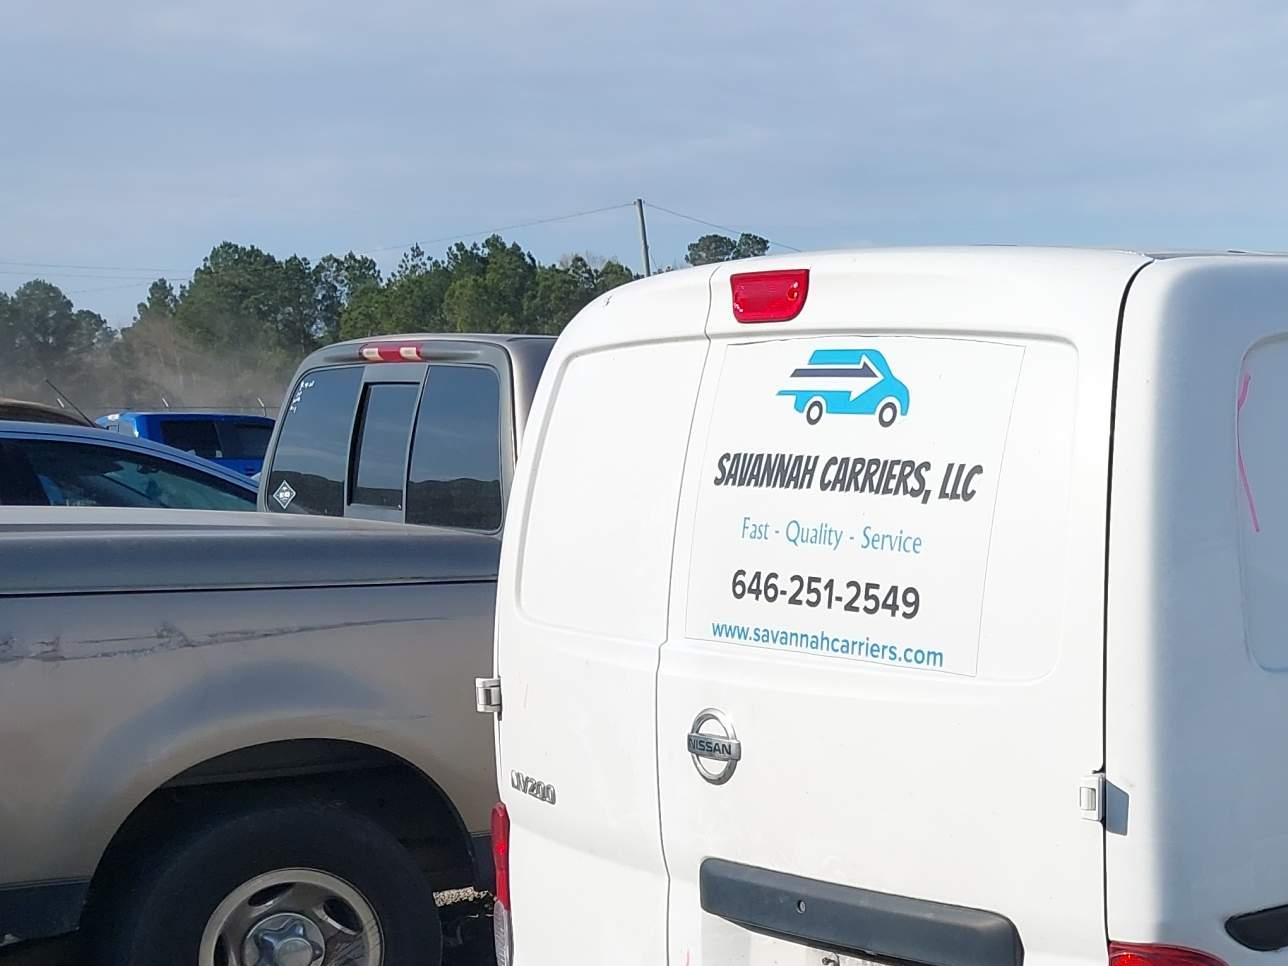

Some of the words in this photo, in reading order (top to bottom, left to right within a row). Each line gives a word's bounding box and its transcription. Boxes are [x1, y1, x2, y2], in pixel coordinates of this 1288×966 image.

[714, 453, 820, 490] SAVANNAH
[819, 456, 932, 505] CARRIERS,
[937, 463, 984, 502] LLC
[741, 517, 770, 541] Fast
[785, 520, 844, 551] Quality
[860, 526, 923, 554] Service
[731, 569, 920, 619] 646-251-2549
[711, 621, 944, 668] www.savannahcarriers.com
[688, 738, 732, 756] NISSAN
